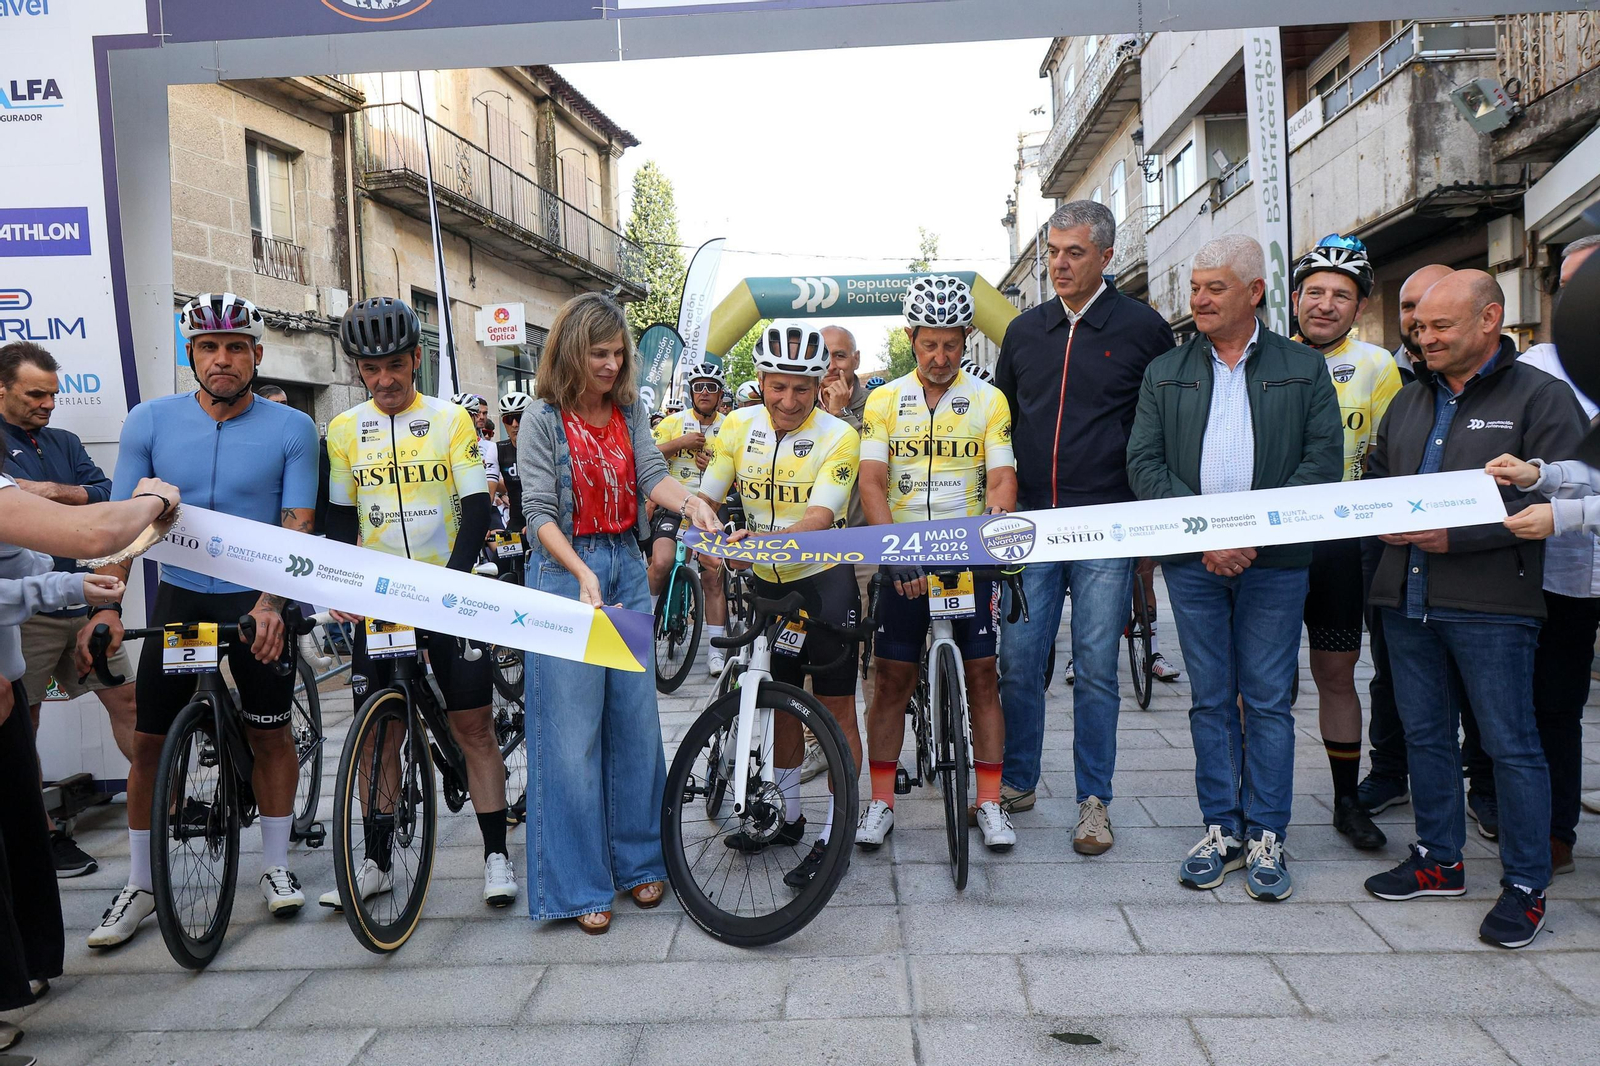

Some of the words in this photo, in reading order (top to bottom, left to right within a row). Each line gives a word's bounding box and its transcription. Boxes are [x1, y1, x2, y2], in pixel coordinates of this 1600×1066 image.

[847, 277, 919, 292] Deputaci
[847, 292, 907, 304] Ponteve
[487, 325, 518, 334] General
[681, 293, 697, 365] Deputación
[689, 294, 705, 366] Pontevedra
[645, 336, 669, 383] Deputación
[652, 339, 675, 385] Pontevedra
[904, 425, 954, 433] GRUPO
[366, 450, 418, 460] GRUPO
[747, 466, 795, 478] GRUPO
[1351, 501, 1393, 512] Xacobeo
[385, 509, 438, 518] PONTEAREAS
[1281, 509, 1307, 517] XUNTA
[1294, 514, 1324, 522] GALICIA
[1354, 512, 1374, 520] 2027
[1210, 514, 1256, 524] Deputación
[1128, 523, 1179, 533] PONTEAREAS
[1211, 521, 1257, 529] Pontevedra
[881, 532, 923, 554] 24
[925, 528, 967, 541] MAIO
[930, 541, 969, 552] 2026
[226, 552, 255, 562] CONCELLO
[227, 545, 283, 564] PONTEAREAS
[800, 551, 865, 562] PINO
[880, 553, 970, 562] PONTEAREAS
[317, 564, 365, 581] Deputación
[315, 571, 363, 587] Pontevedra
[391, 581, 417, 592] XUNTA
[388, 588, 399, 596] DE
[400, 591, 430, 603] GALICIA
[460, 596, 500, 613] Xacobeo
[944, 597, 960, 609] 18
[457, 607, 478, 617] 2027
[780, 631, 799, 644] 40
[183, 648, 196, 661] 2
